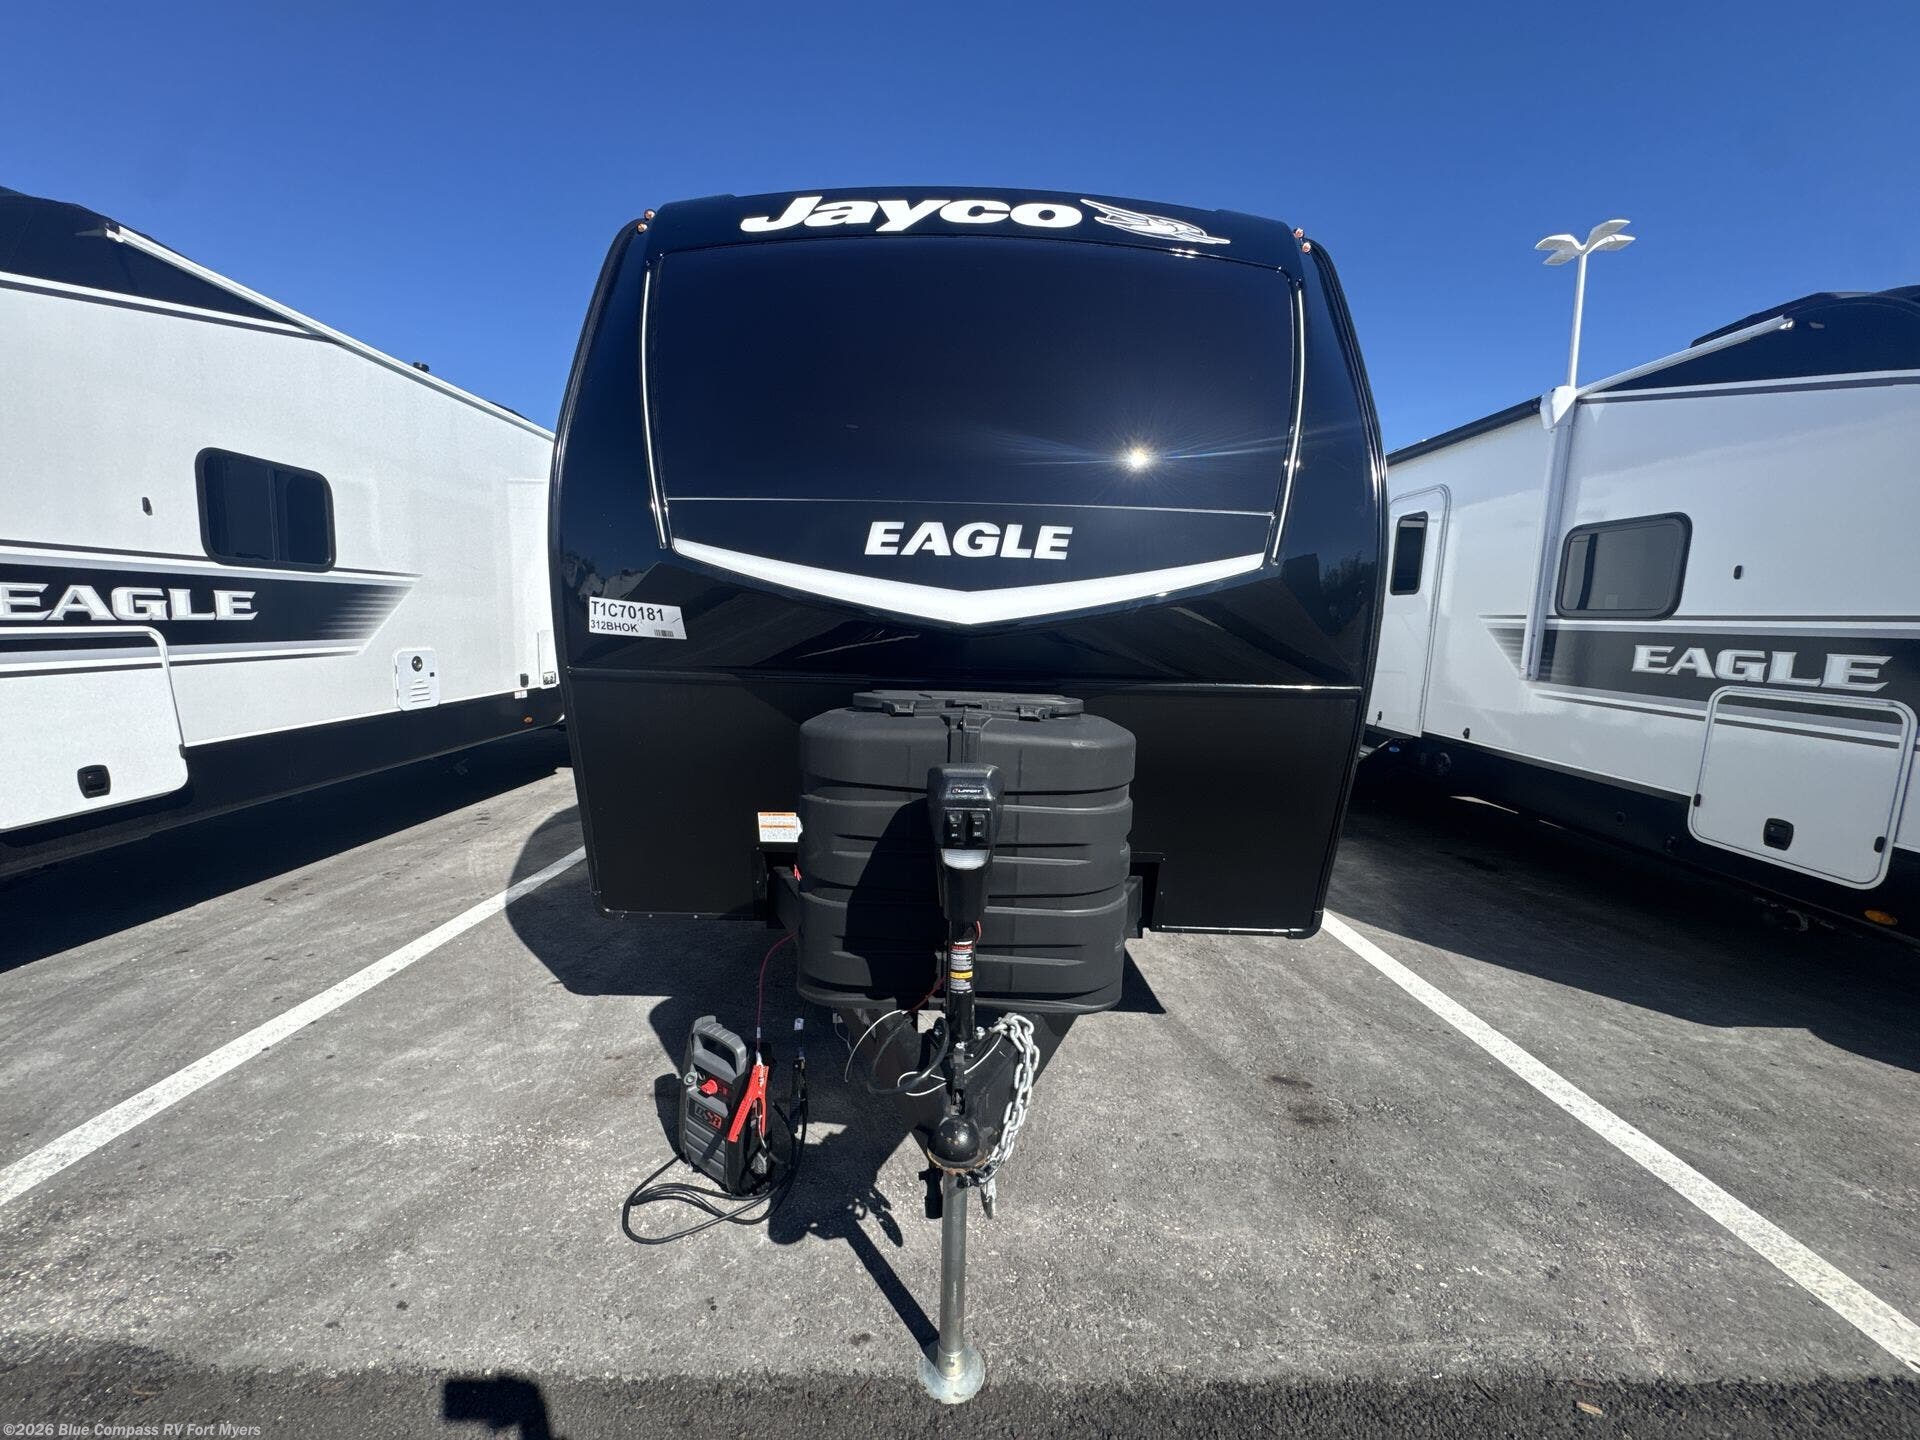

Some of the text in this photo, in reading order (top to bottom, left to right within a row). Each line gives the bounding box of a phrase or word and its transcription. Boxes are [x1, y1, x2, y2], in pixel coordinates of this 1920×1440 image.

[740, 195, 1083, 233] Jayco
[864, 520, 1074, 561] EAGLE
[0, 582, 259, 621] EAGLE
[591, 600, 665, 622] T1C70181
[590, 620, 639, 633] 312BHOK
[1631, 643, 1893, 692] EAGLE
